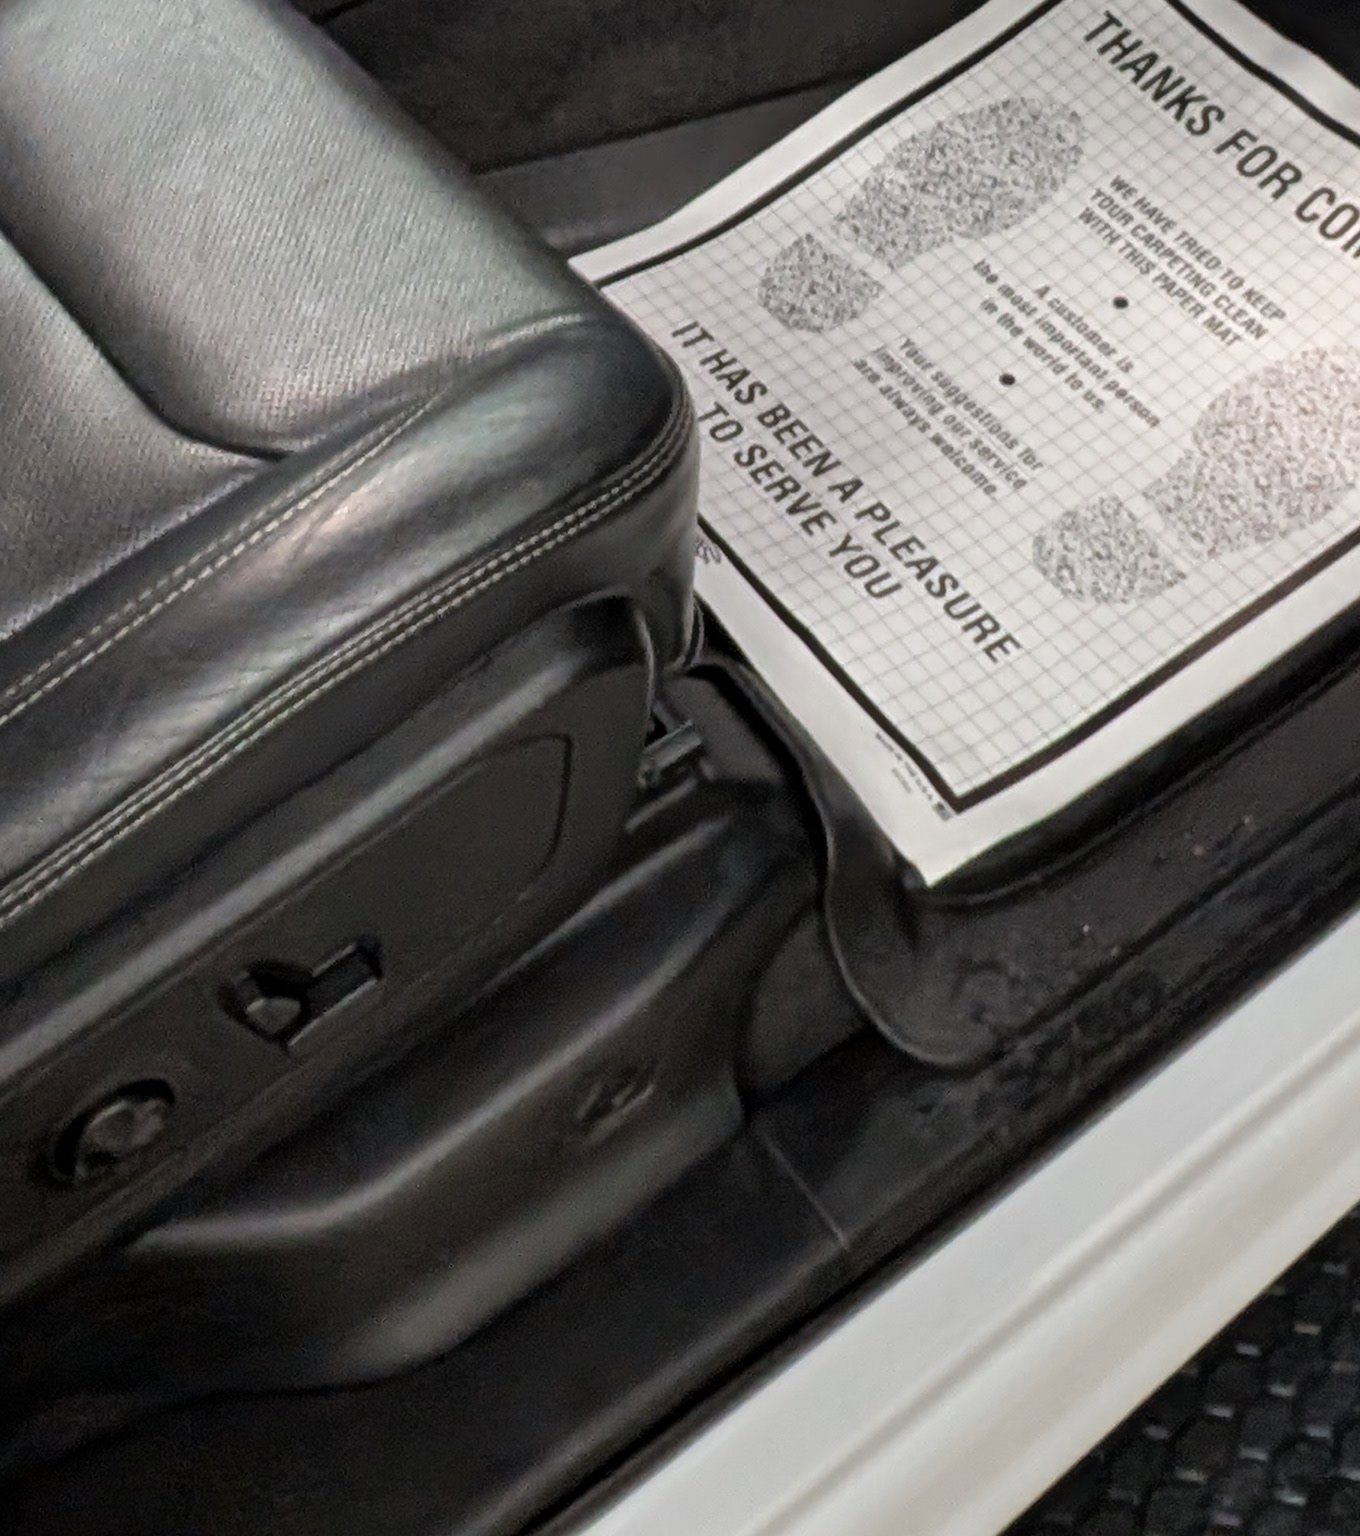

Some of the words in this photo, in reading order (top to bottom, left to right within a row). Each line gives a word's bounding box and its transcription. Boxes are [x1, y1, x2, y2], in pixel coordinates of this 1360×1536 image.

[1083, 11, 1225, 137] THANKS
[1214, 128, 1303, 202] FOR
[1078, 207, 1121, 246] WITH
[1118, 239, 1157, 275] THIS
[1152, 272, 1207, 318] PAPER
[1202, 316, 1242, 347] MAT
[1092, 188, 1134, 227] YOUR
[1130, 224, 1217, 298] CARPETING
[1213, 294, 1269, 340] CLEAN
[1110, 175, 1138, 201] WE
[1134, 196, 1177, 234] HAVE
[1174, 230, 1223, 271] TRIED
[1219, 268, 1245, 290] TO
[1242, 288, 1287, 321] KEEP
[853, 359, 882, 384] are
[879, 385, 931, 433] always
[973, 259, 999, 284] the
[997, 284, 1038, 317] most
[1034, 316, 1109, 380] important
[1102, 380, 1160, 428] person
[980, 298, 998, 314] in
[996, 312, 1024, 338] the
[1023, 336, 1069, 375] world
[1065, 372, 1084, 391] to
[1034, 285, 1051, 300] A
[1047, 297, 1117, 357] customer
[1116, 356, 1134, 373] is
[873, 347, 945, 416] improving
[942, 413, 972, 438] our
[968, 438, 1028, 491] service
[900, 337, 934, 371] Your
[931, 370, 1019, 450] suggestions
[1017, 447, 1044, 470] for
[671, 321, 715, 348] IT
[699, 348, 768, 406] HAS
[757, 403, 841, 478] BEEN
[828, 477, 864, 503] A
[854, 501, 1022, 664] PLEASURE
[698, 401, 745, 443] TO
[733, 444, 837, 537] SERVE
[828, 533, 902, 600] YOU
